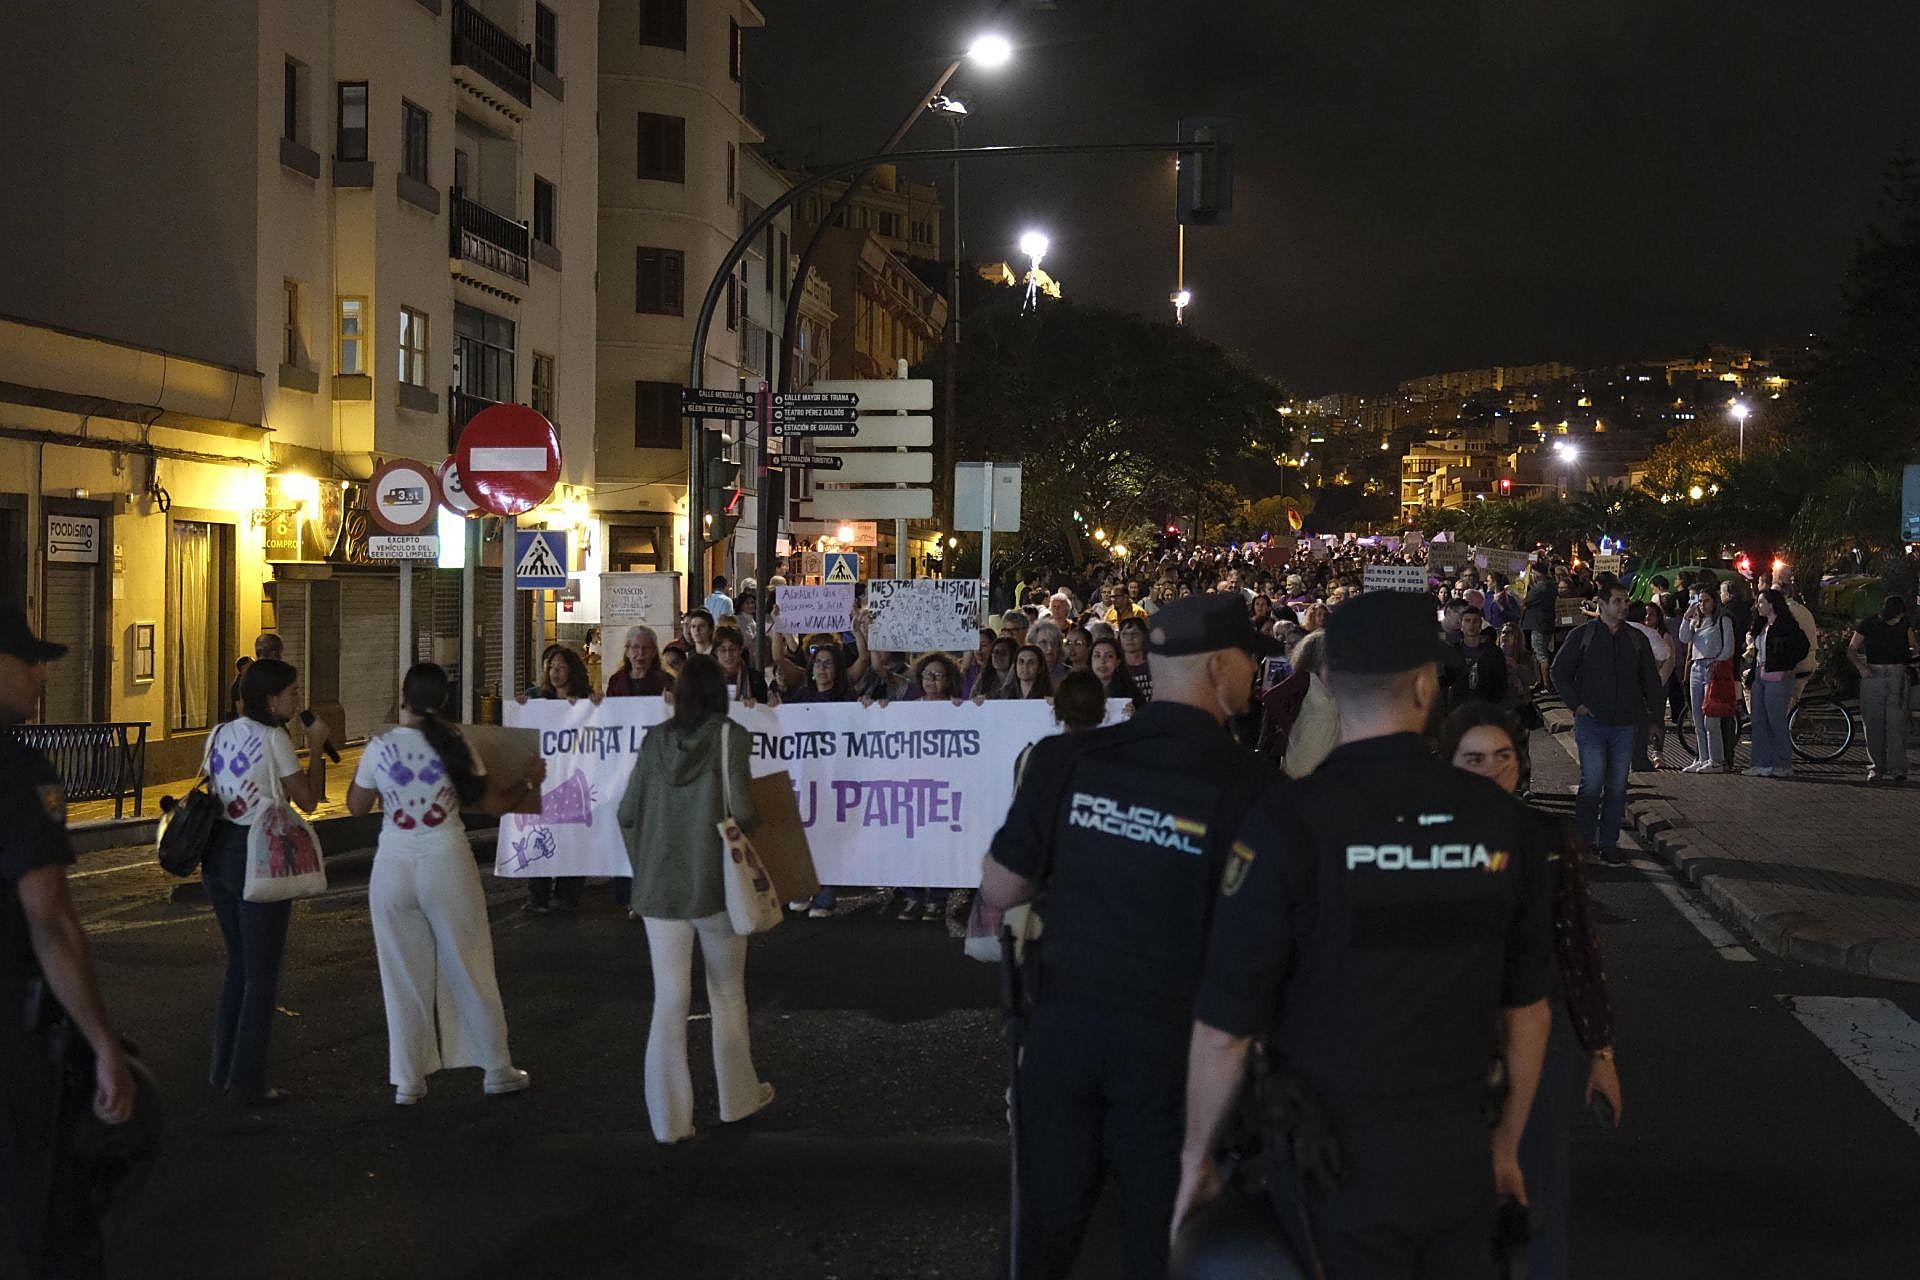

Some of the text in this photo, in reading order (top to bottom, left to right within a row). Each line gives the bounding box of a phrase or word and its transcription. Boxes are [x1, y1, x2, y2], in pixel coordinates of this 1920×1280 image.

[805, 408, 822, 416] PÉREZ
[823, 408, 845, 416] GALDÓS
[784, 423, 809, 431] ESTACIÓN
[266, 539, 297, 549] COMPRO
[934, 580, 976, 601] HISTORIA
[543, 725, 623, 760] CONTRA
[749, 731, 837, 760] ENCIAS
[842, 729, 980, 759] MACHISTAS
[831, 779, 963, 839] PARTE!
[1072, 792, 1176, 831] POLICIA
[1069, 809, 1202, 855] NACIONAL
[1346, 844, 1490, 870] POLICIA
